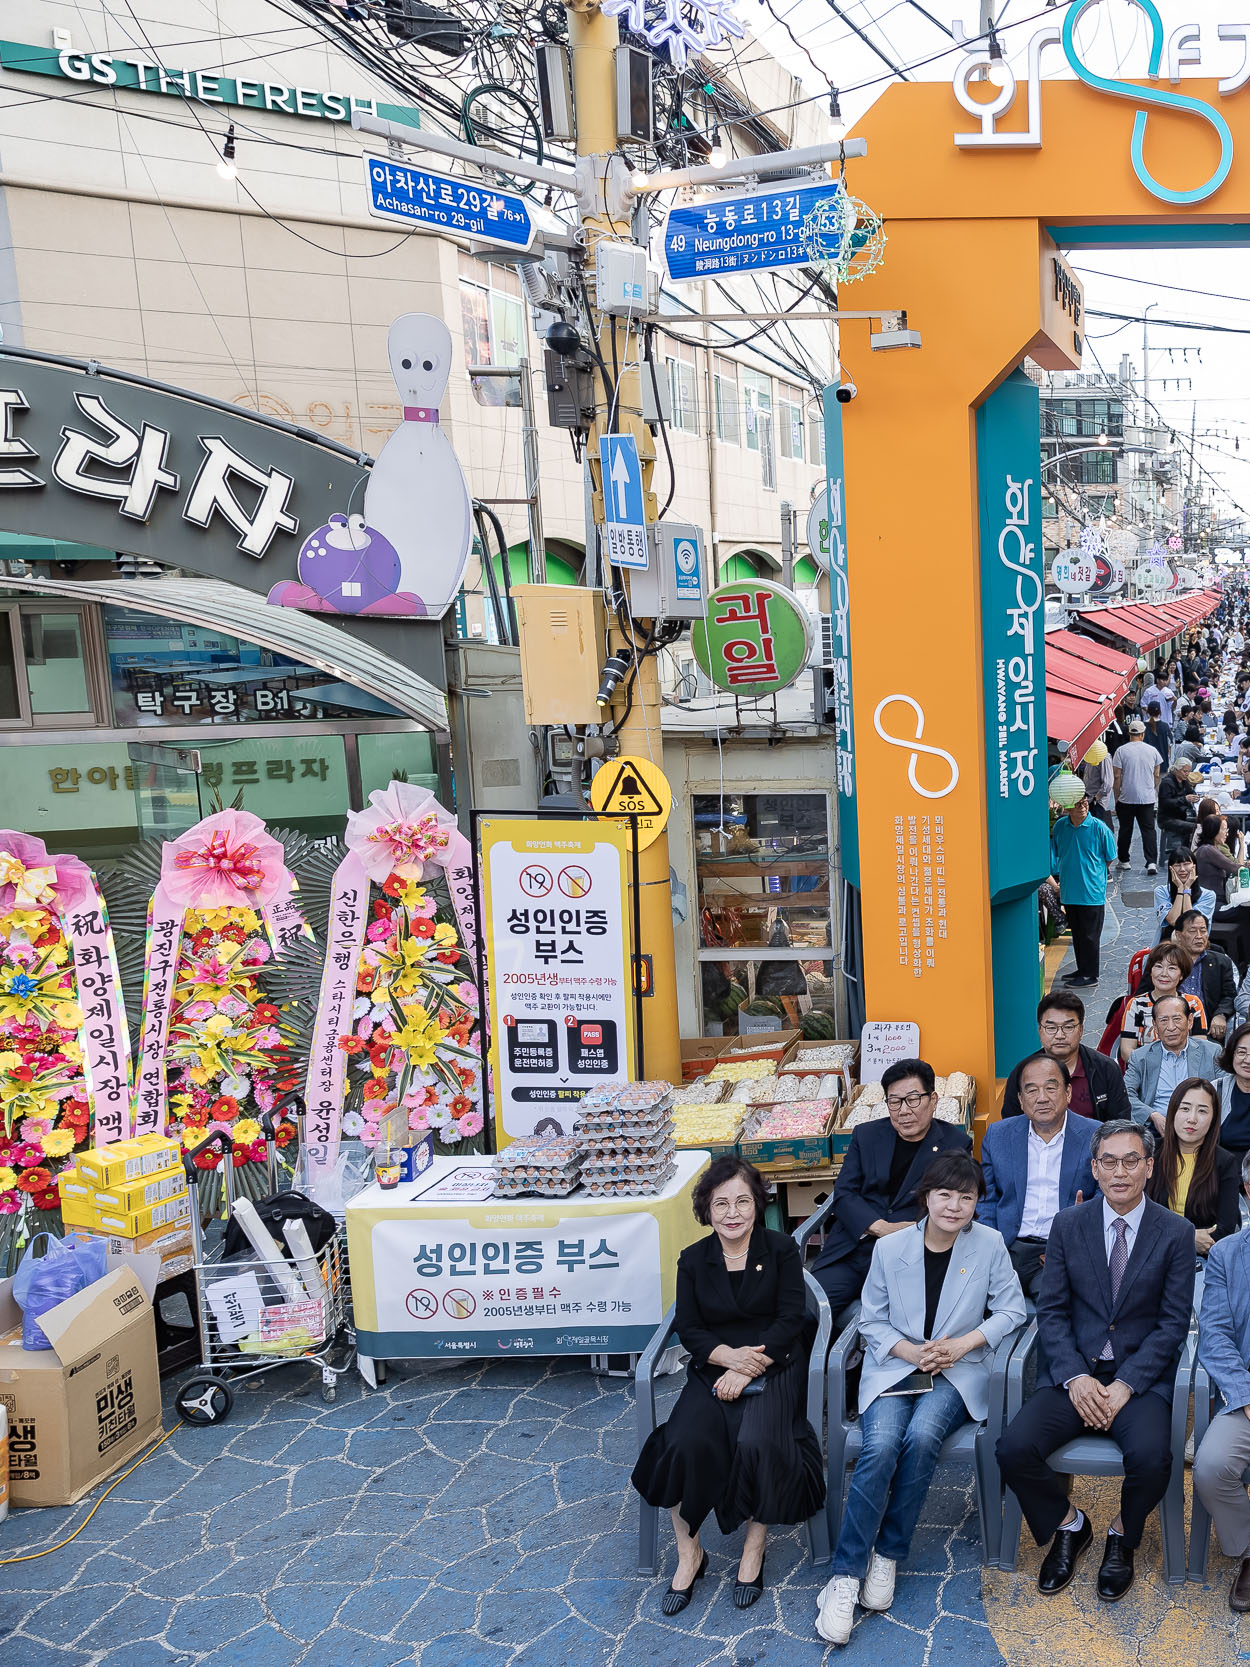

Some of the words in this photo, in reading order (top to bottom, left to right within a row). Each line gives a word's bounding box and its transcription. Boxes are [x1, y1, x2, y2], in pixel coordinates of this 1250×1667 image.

[58, 48, 117, 85] GS
[126, 58, 224, 102] THE
[235, 77, 377, 122] FRESH
[372, 165, 499, 221] 아차산로29길
[376, 193, 448, 222] Achasan-ro
[451, 211, 485, 232] 29-gil
[703, 194, 801, 233] 능동로13길
[669, 234, 686, 252] 49
[693, 229, 777, 253] Neungdong-ro
[608, 527, 645, 559] 일방통행
[714, 591, 781, 686] 과일
[137, 691, 237, 715] 탁구장
[996, 658, 1007, 723] HWAYANG
[997, 725, 1008, 748] JEIL
[998, 750, 1009, 798] MARKET
[618, 800, 646, 812] SOS
[907, 815, 917, 845] 발전을
[921, 815, 932, 865] 기성세대와
[934, 815, 945, 865] 뫼비우스의
[894, 815, 905, 884] 화양제일시장의
[525, 872, 546, 890] 19
[908, 847, 920, 906] 이뤄나간다는
[923, 866, 933, 916] 젊은세대가
[936, 867, 946, 887] 띠는
[937, 888, 947, 918] 전통과
[71, 910, 104, 937] 祝
[332, 889, 360, 971] 신한은행
[507, 908, 608, 936] 성인인증
[911, 907, 920, 938] 컨셉을
[924, 917, 935, 948] 조화를
[938, 919, 948, 939] 현대
[534, 939, 584, 965] 부스
[898, 917, 908, 966] 로고입니다
[912, 938, 922, 978] 형상화한
[925, 948, 935, 968] 이뤄
[143, 919, 180, 1061] 광진구전통시장
[503, 972, 573, 987] 2005년생부터
[573, 977, 586, 986] 맥주
[588, 977, 602, 987] 수령
[603, 977, 617, 987] 가능
[510, 992, 537, 1001] 성인인증
[539, 992, 553, 1001] 확인
[554, 992, 561, 1001] 후
[524, 1003, 539, 1011] 맥주
[561, 1003, 598, 1012] 가능합니다.
[76, 945, 127, 1102] 화양제일시장
[505, 1015, 512, 1025] 1
[567, 1016, 574, 1026] 2
[583, 1031, 600, 1039] PASS
[318, 979, 347, 1093] 스타시티금융센터장
[885, 1033, 902, 1042] 1000
[513, 1047, 553, 1057] 주민등록증
[514, 1058, 554, 1068] 운전면허증
[576, 1059, 609, 1069] 성인인증
[580, 1048, 605, 1058] 패스앱
[529, 1089, 557, 1098] 성인인증
[97, 1110, 125, 1145] 맥
[306, 1099, 336, 1166] 윤성일
[412, 1240, 545, 1277] 성인인증
[556, 1238, 620, 1273] 부스
[411, 1295, 431, 1312] 19
[483, 1303, 557, 1318] 2005년생부터
[560, 1303, 583, 1315] 맥주
[586, 1301, 608, 1313] 수령
[610, 1300, 632, 1313] 가능
[444, 1341, 477, 1349] 서울특별시
[96, 1375, 134, 1426] 민생
[98, 1402, 136, 1439] 키친타월
[8, 1425, 37, 1453] 생
